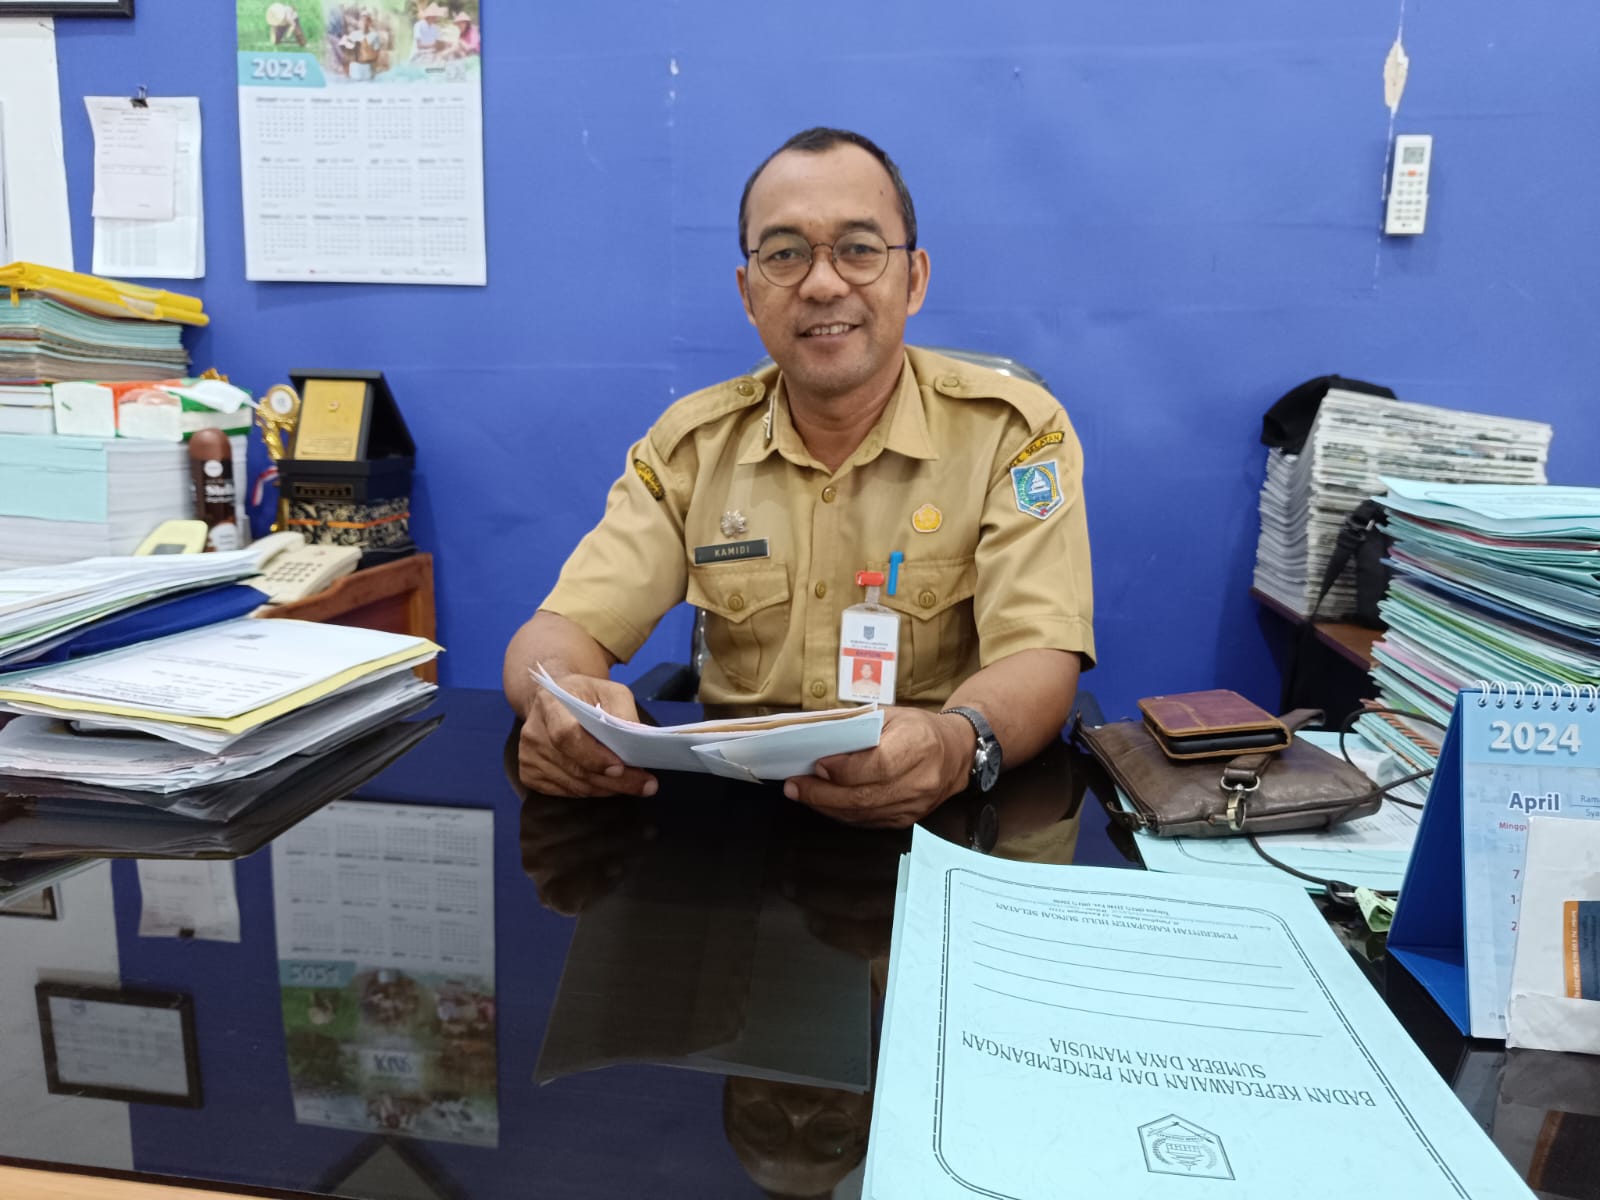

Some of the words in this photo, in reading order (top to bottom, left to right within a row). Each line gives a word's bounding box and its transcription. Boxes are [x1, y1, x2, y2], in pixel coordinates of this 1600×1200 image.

[251, 57, 307, 80] 2024
[714, 545, 751, 558] KAMIDI
[1489, 719, 1583, 754] 2024
[1508, 792, 1561, 814] April
[1512, 869, 1521, 880] 7
[995, 902, 1039, 917] SELATAN
[1041, 911, 1079, 923] SUNGAI
[1081, 917, 1109, 926] HULU
[1111, 919, 1171, 933] KABUPATEN
[1172, 926, 1239, 940] PEMERINTAH
[961, 1030, 1114, 1082] PENGEMBANGAN
[1049, 1036, 1132, 1065] MANUSIA
[1135, 1050, 1185, 1071] DAYA
[1117, 1067, 1160, 1088] DAN
[1187, 1056, 1267, 1079] SUMBER
[1164, 1072, 1302, 1101] KEPEGAWAIAN
[1303, 1086, 1377, 1107] BADAN
